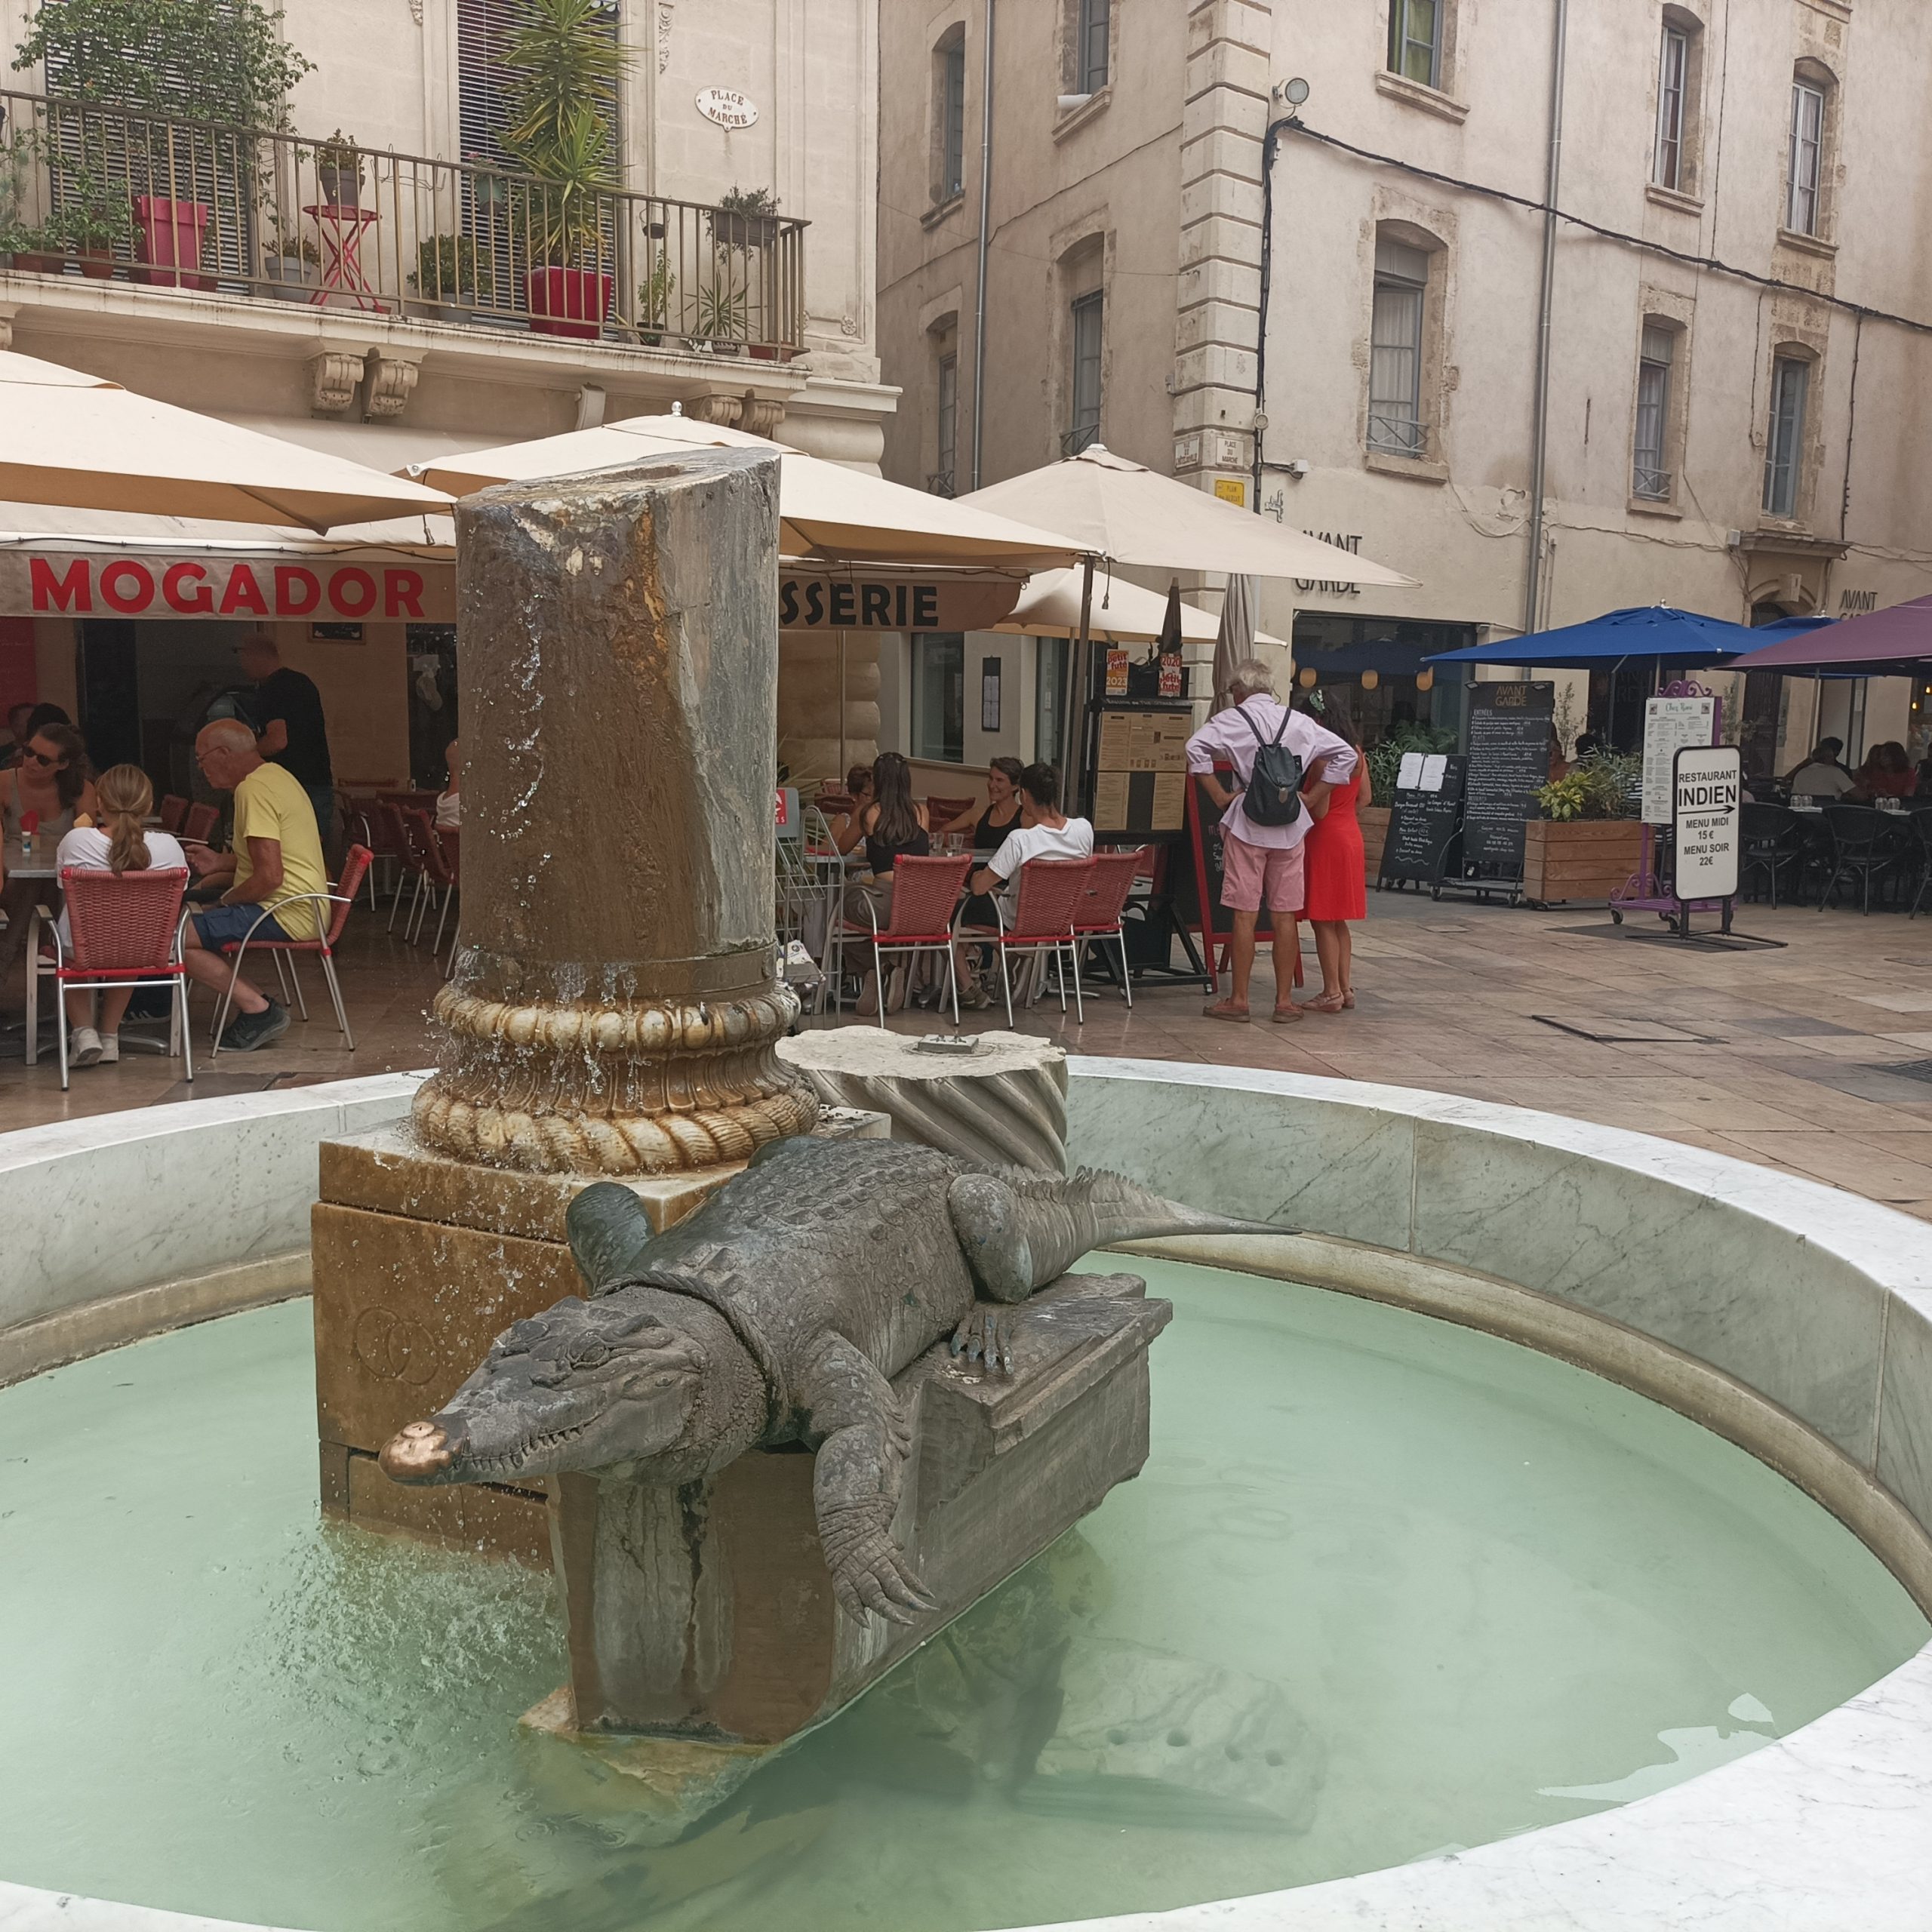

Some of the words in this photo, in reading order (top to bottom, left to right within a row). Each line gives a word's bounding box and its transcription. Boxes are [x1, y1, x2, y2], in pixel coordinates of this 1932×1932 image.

[711, 90, 744, 106] PLACE
[708, 107, 748, 125] MARCHÉ
[1224, 440, 1238, 448] PLACE
[29, 558, 426, 617] MOGADOR
[1840, 589, 1878, 611] AVANT
[1108, 652, 1128, 664] petit
[1162, 657, 1181, 667] 2020
[1106, 676, 1127, 686] 2023
[1497, 685, 1527, 695] AVANT
[1495, 696, 1527, 706] GARDE
[1678, 770, 1737, 783] RESTAURANT
[1678, 784, 1737, 807] INDIEN
[1686, 819, 1709, 829] MENU
[1712, 817, 1729, 826] MIDI
[1698, 831, 1707, 840] 15
[1709, 830, 1714, 839] €
[1684, 844, 1707, 855] MENU
[1709, 843, 1730, 853] SOIR
[1700, 856, 1713, 866] 22€
